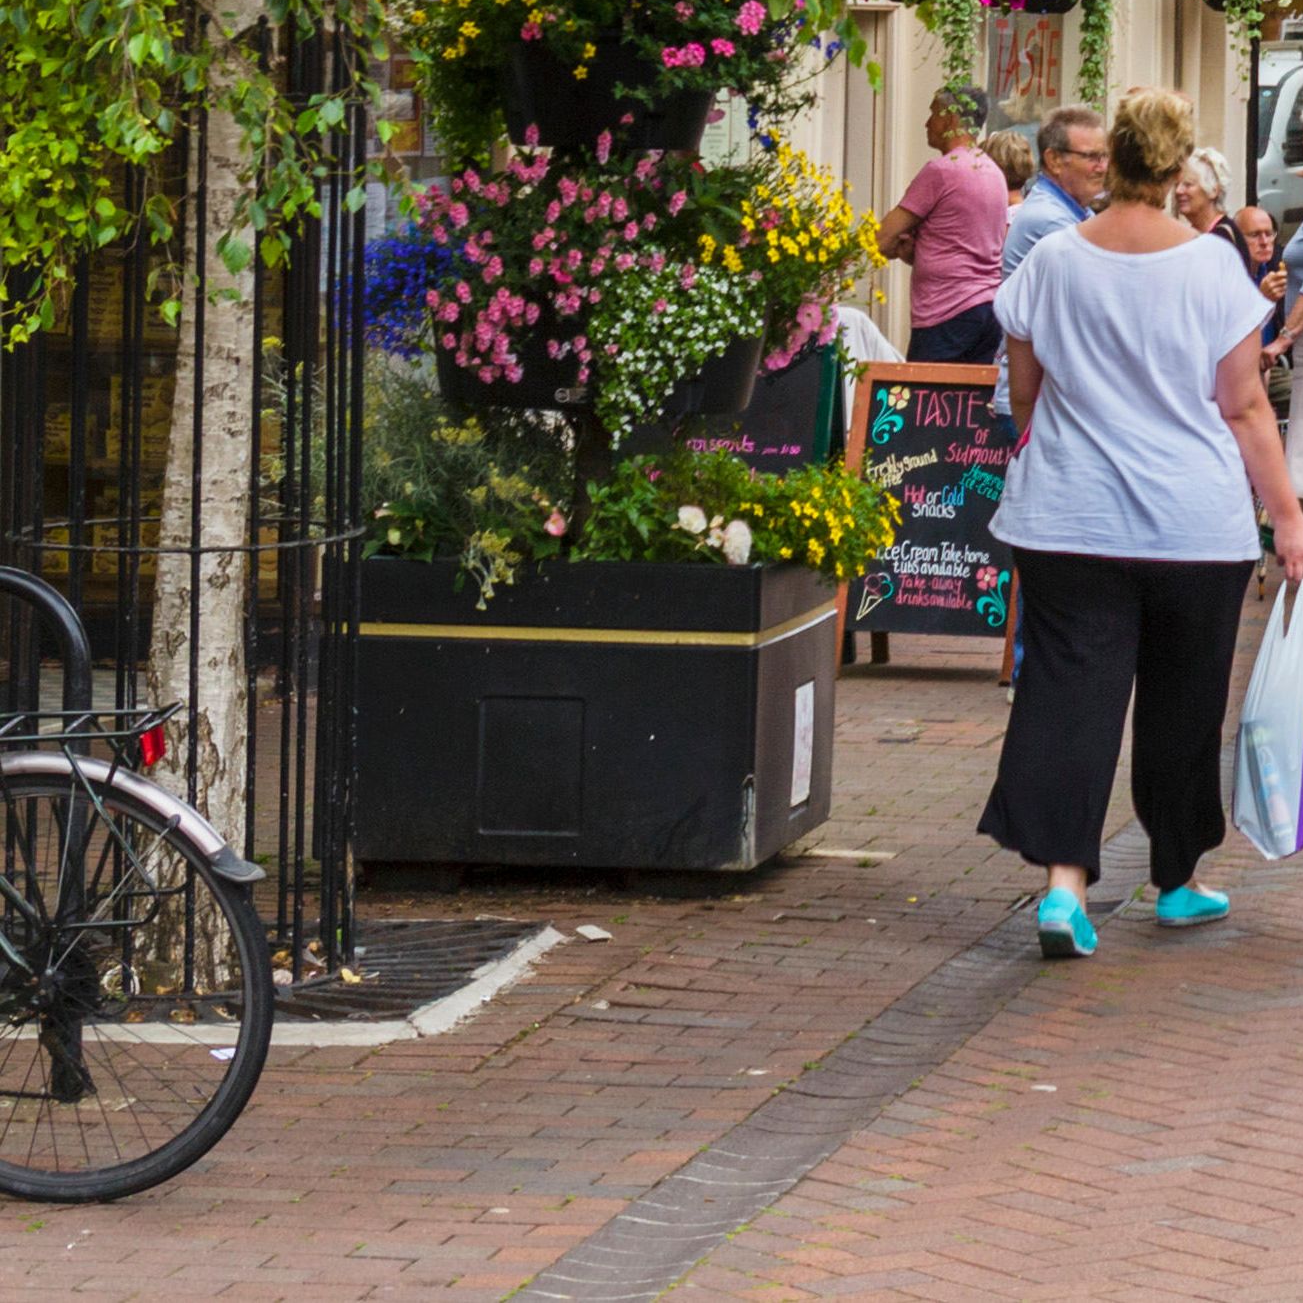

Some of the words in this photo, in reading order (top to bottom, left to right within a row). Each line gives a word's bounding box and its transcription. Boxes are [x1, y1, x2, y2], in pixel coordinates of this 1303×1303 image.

[995, 18, 1061, 98] TASTE
[914, 389, 984, 428] TASTE
[945, 443, 1013, 467] Sidmouth
[904, 484, 927, 504] Hot
[926, 490, 941, 505] or
[941, 484, 965, 506] Cold
[900, 540, 939, 561] Cream
[893, 560, 920, 574] tubs
[920, 561, 971, 578] available
[896, 590, 927, 606] drinks
[927, 593, 973, 610] available
